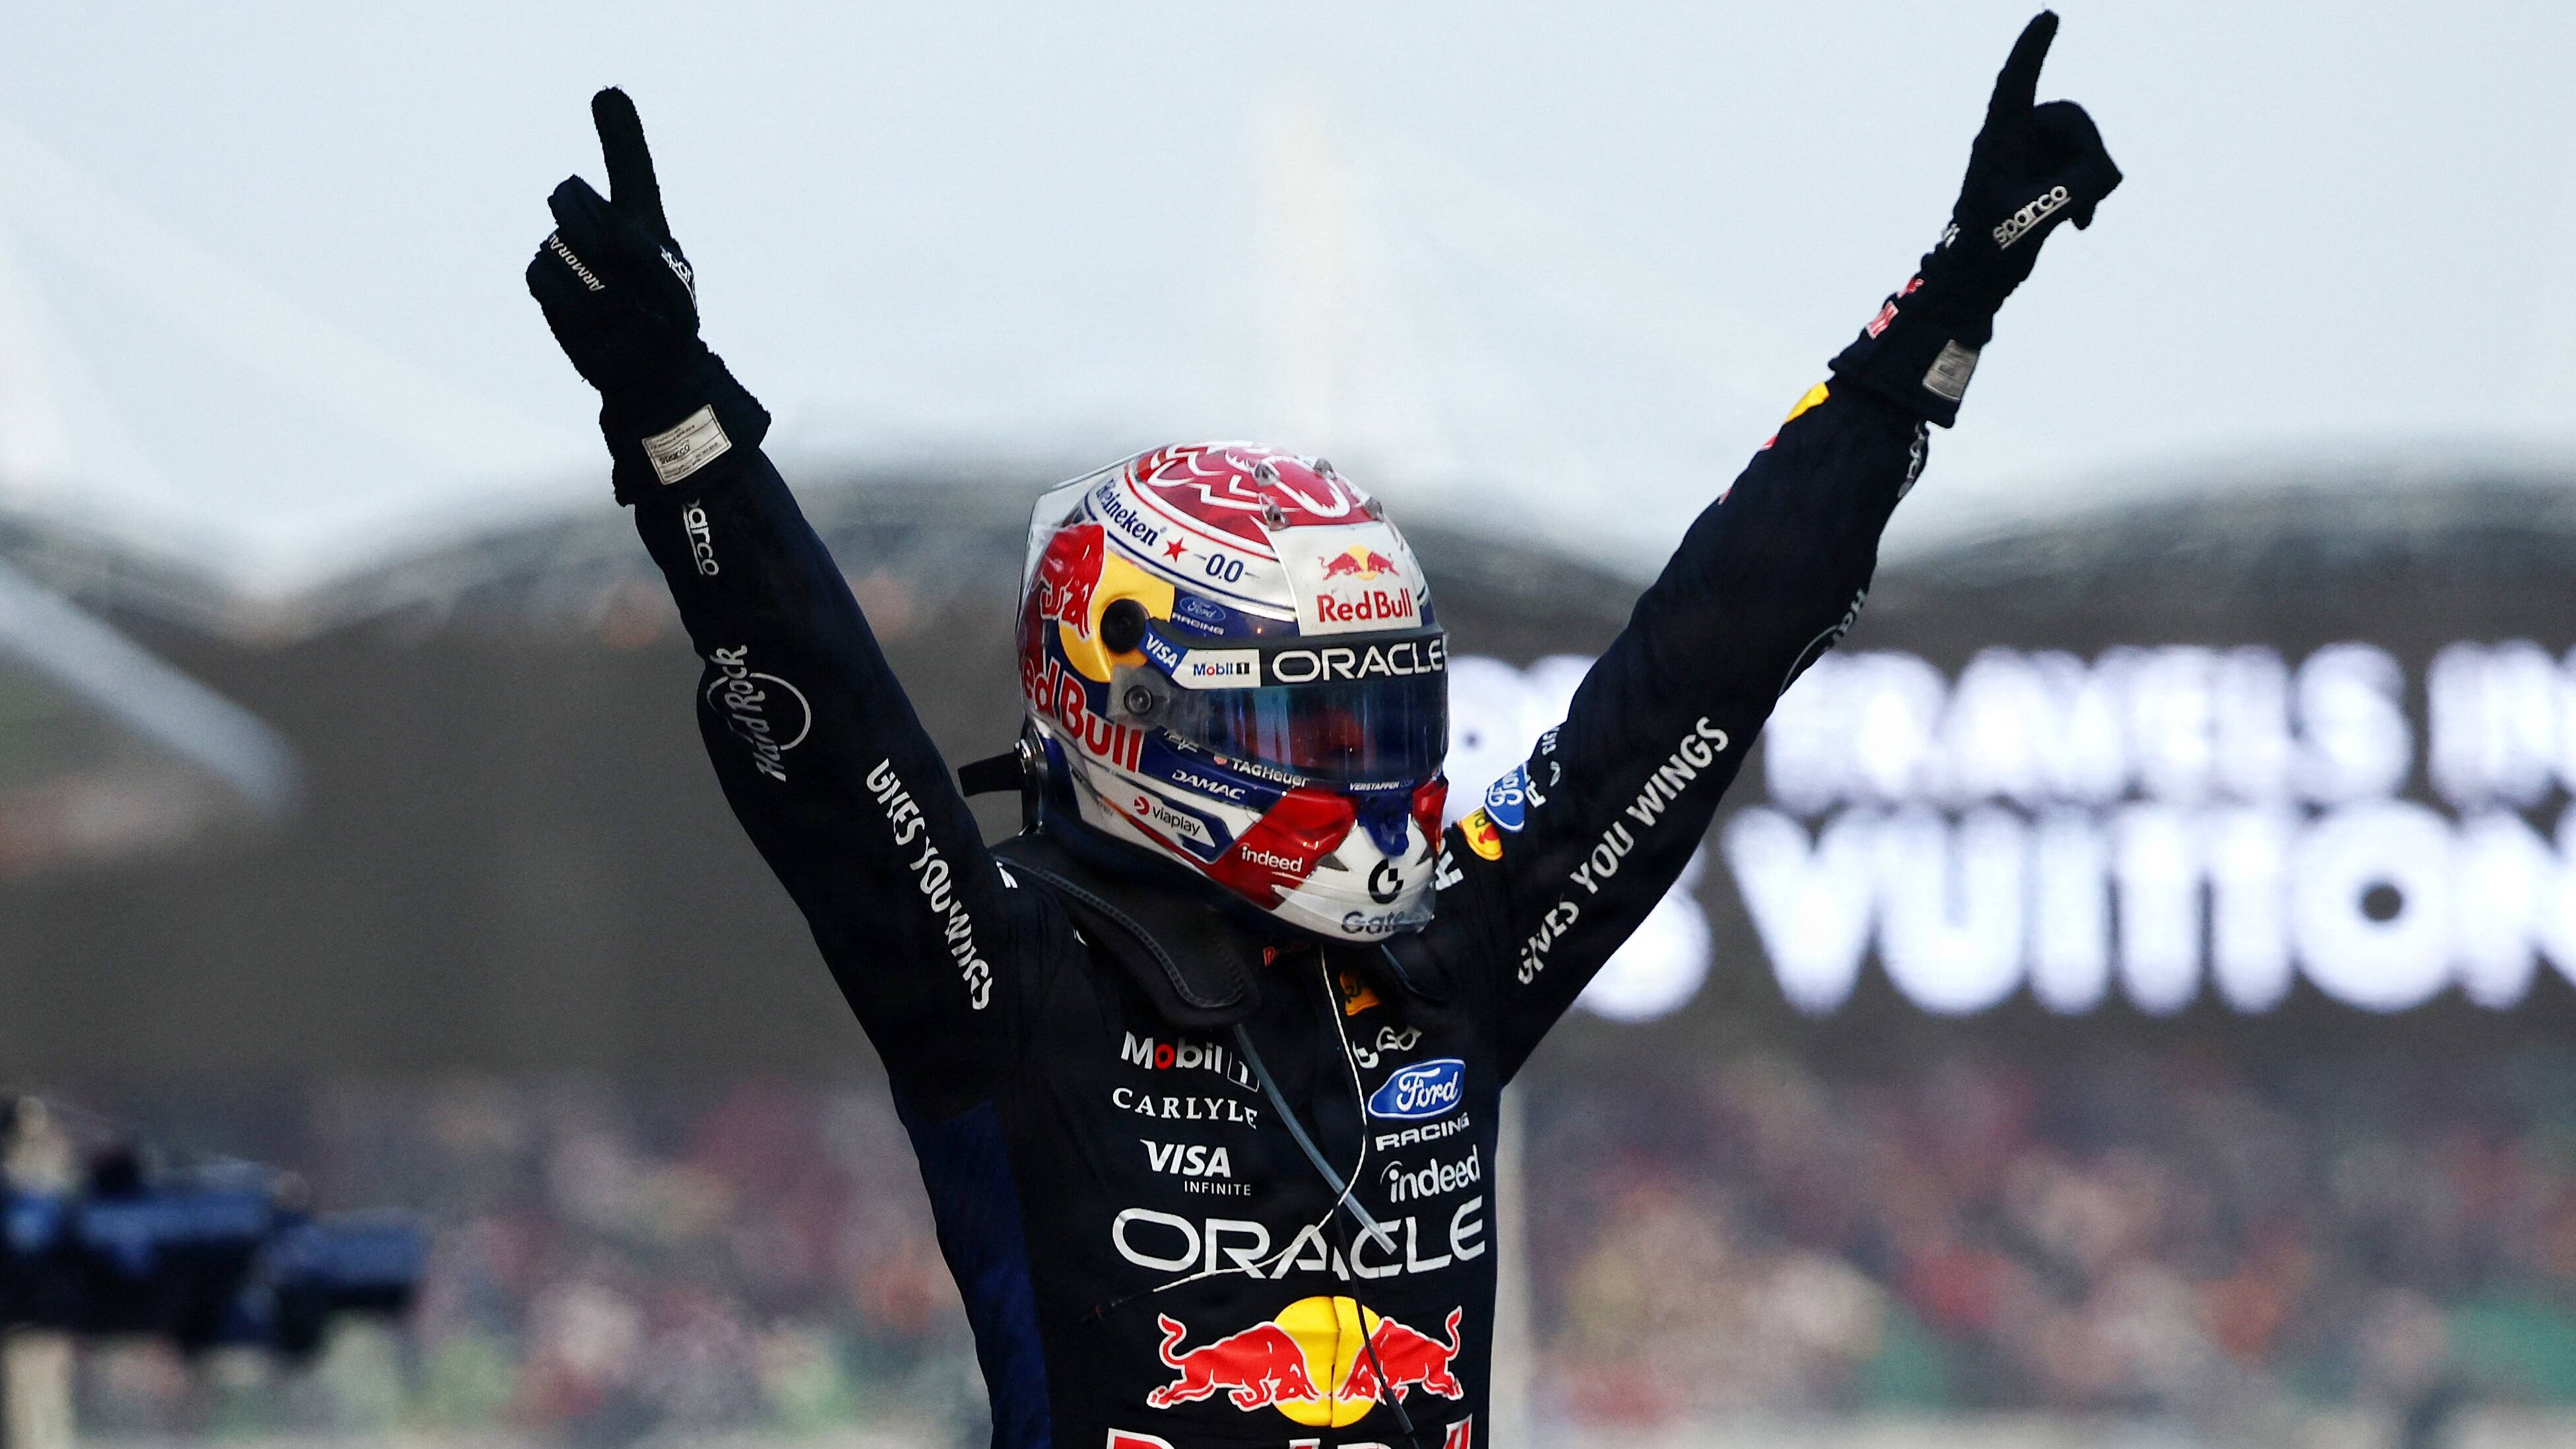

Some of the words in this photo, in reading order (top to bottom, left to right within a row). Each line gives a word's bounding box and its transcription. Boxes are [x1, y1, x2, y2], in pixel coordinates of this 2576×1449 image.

[1993, 185, 2070, 247] sparco
[1096, 478, 1159, 547] Heineken
[684, 498, 719, 576] arco
[1316, 590, 1372, 623] Red
[1374, 587, 1413, 618] Bull
[1145, 632, 1178, 668] VISA
[1193, 662, 1233, 676] Mobil
[1272, 639, 1443, 683] ORACLE
[710, 644, 765, 712] Rock
[1022, 657, 1060, 719] ed
[1059, 671, 1145, 774] Bull
[1172, 769, 1246, 800] DAMAC
[1569, 820, 1634, 895] YOU
[1625, 716, 1729, 827] WINGS
[1153, 805, 1201, 836] viaplay
[909, 836, 951, 913] YOU
[1241, 843, 1303, 873] indeed
[1121, 1030, 1223, 1074] Mobil
[1112, 1087, 1258, 1130] CARLYLE
[1396, 1066, 1459, 1112] Ford
[1375, 1111, 1470, 1152] RACING
[1139, 1138, 1232, 1178] VISA
[1380, 1143, 1481, 1204] indeed
[1184, 1180, 1252, 1196] INFINITE
[1112, 1195, 1486, 1281] ORACLE
